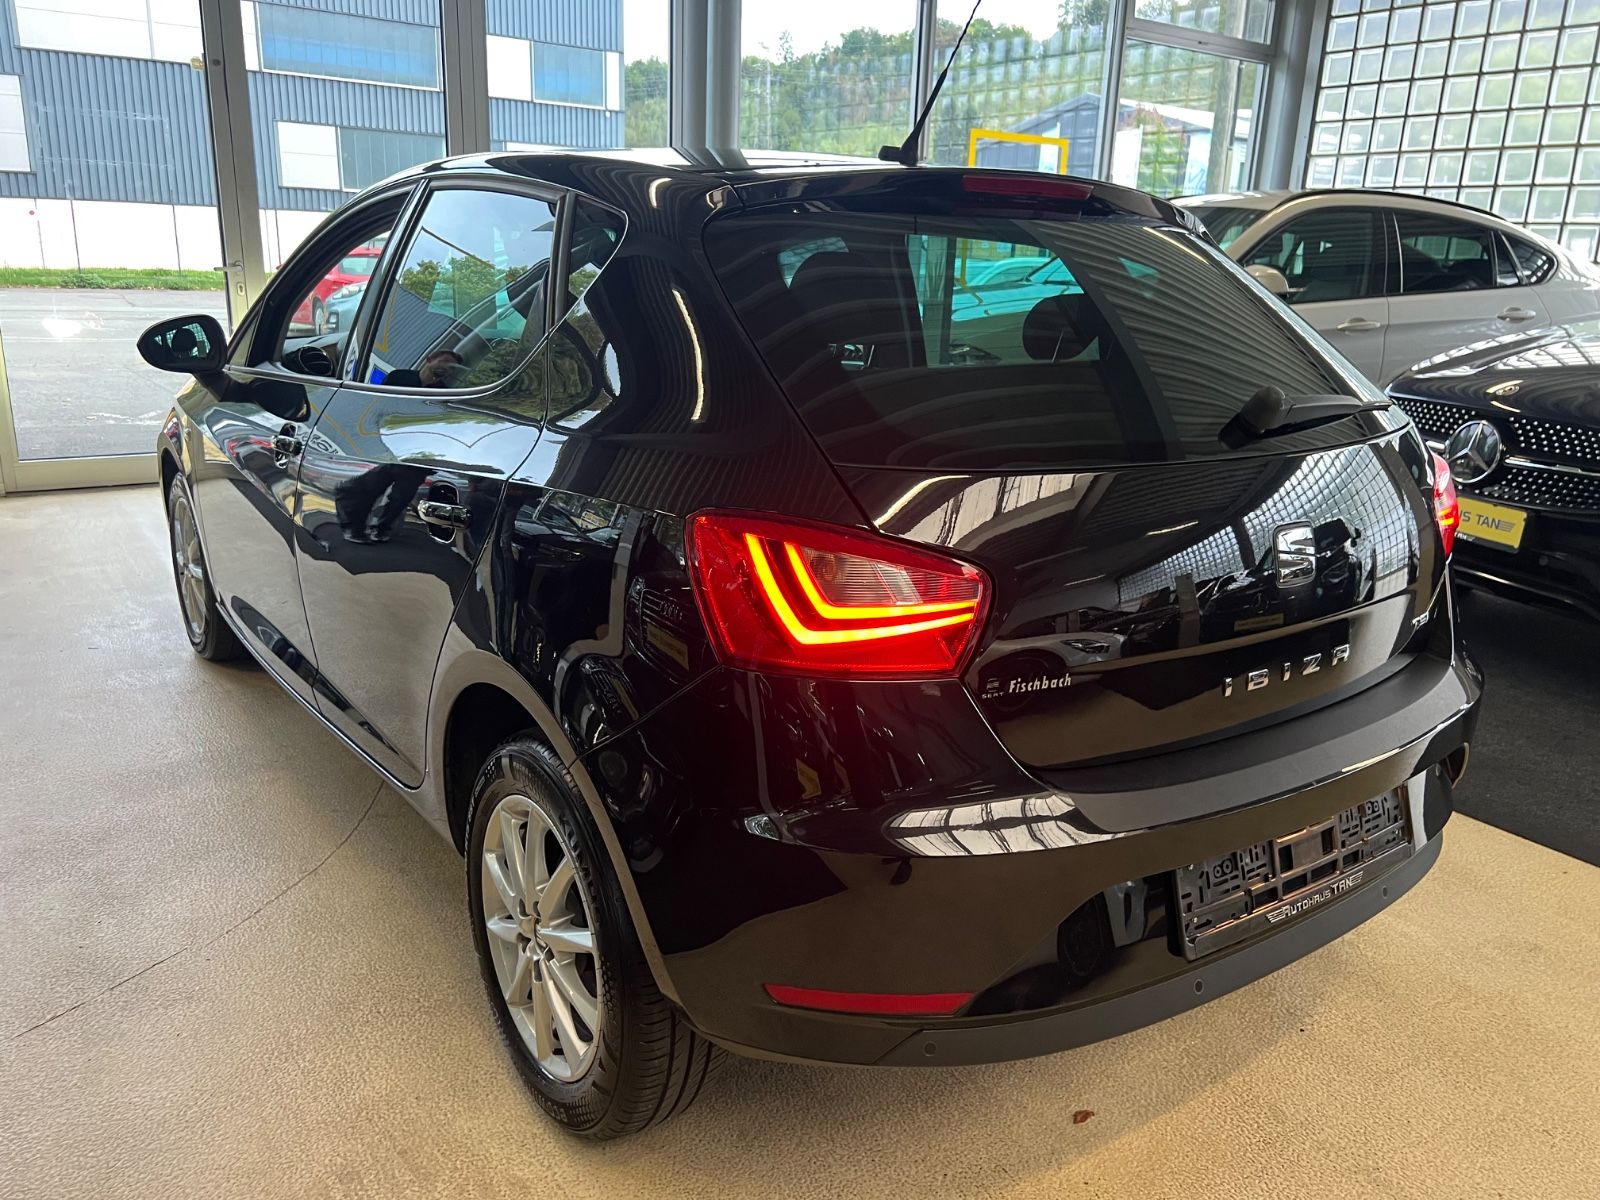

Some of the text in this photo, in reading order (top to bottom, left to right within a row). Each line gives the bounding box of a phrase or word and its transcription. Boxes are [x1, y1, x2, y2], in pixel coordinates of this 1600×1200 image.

[1476, 513, 1500, 530] TAN
[1223, 643, 1350, 697] IBIZA
[1008, 673, 1072, 693] Fischbach
[981, 691, 1004, 699] SEAT
[1280, 877, 1354, 918] AUTOHAUS TAN
